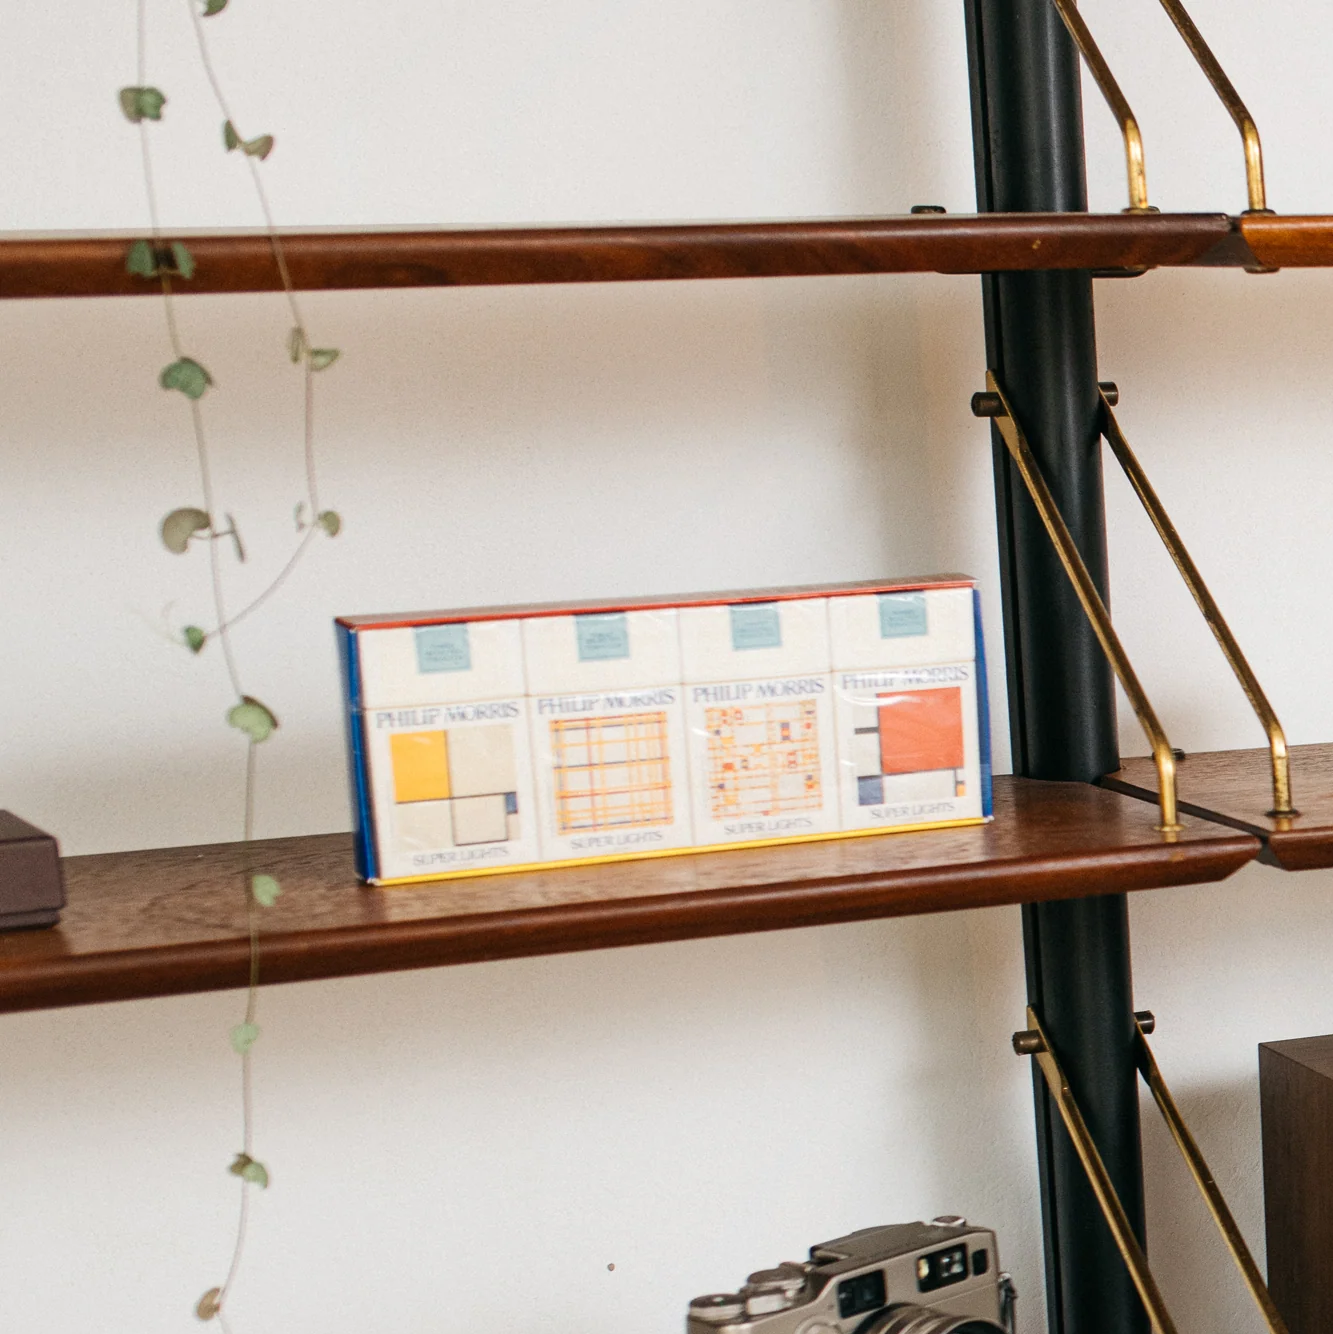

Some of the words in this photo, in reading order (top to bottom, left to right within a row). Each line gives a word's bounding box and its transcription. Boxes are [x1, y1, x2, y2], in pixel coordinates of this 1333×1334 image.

[539, 695, 598, 714] PHILIP
[605, 688, 675, 708] MORRIS
[693, 685, 752, 703] PHILIP
[756, 679, 824, 698] MORRIS
[376, 708, 437, 729] PHILIP
[444, 702, 518, 724] MORRIS
[871, 806, 908, 819] SUPER
[912, 803, 955, 816] LIGHTS
[724, 821, 765, 836] SUPER
[770, 818, 812, 831] LIGHTS
